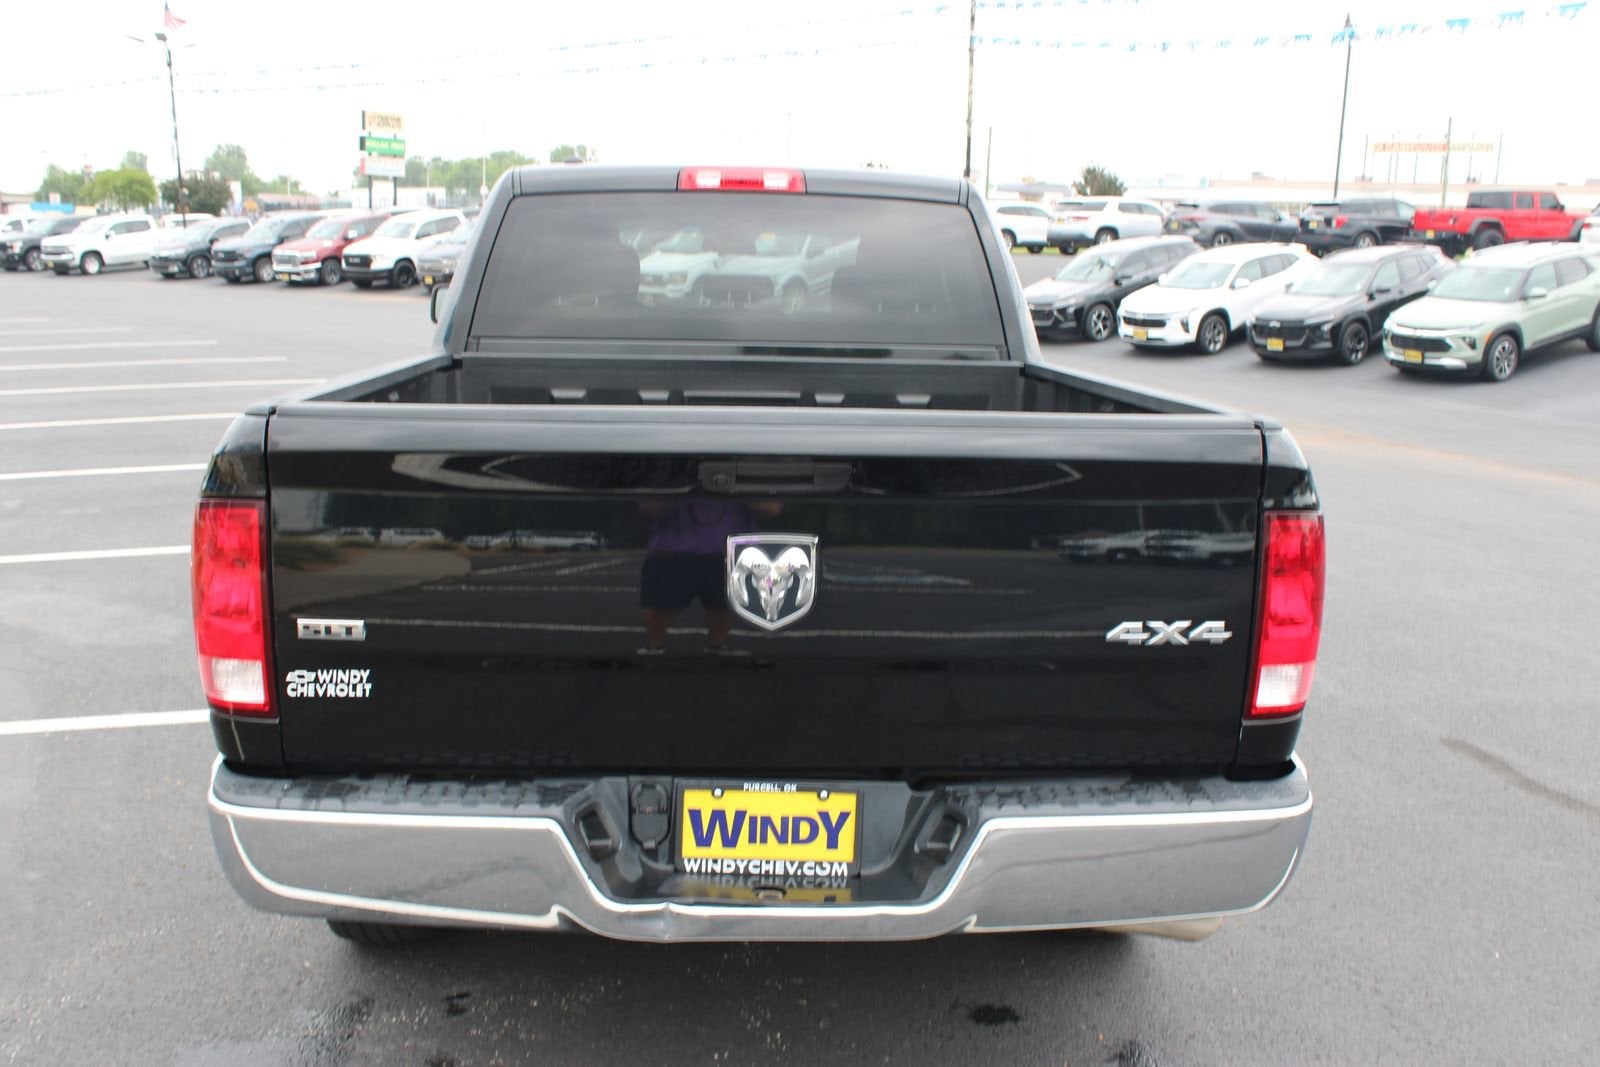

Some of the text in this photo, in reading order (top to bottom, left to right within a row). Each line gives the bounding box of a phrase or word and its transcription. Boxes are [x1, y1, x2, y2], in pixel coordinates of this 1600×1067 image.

[296, 618, 366, 641] SLT
[1105, 619, 1233, 646] 4X4
[317, 668, 371, 684] WINDY
[286, 682, 373, 698] CHEVROLET
[784, 783, 797, 794] OK
[688, 809, 852, 850] WINDY
[683, 857, 849, 877] WINDYCHEV.COM
